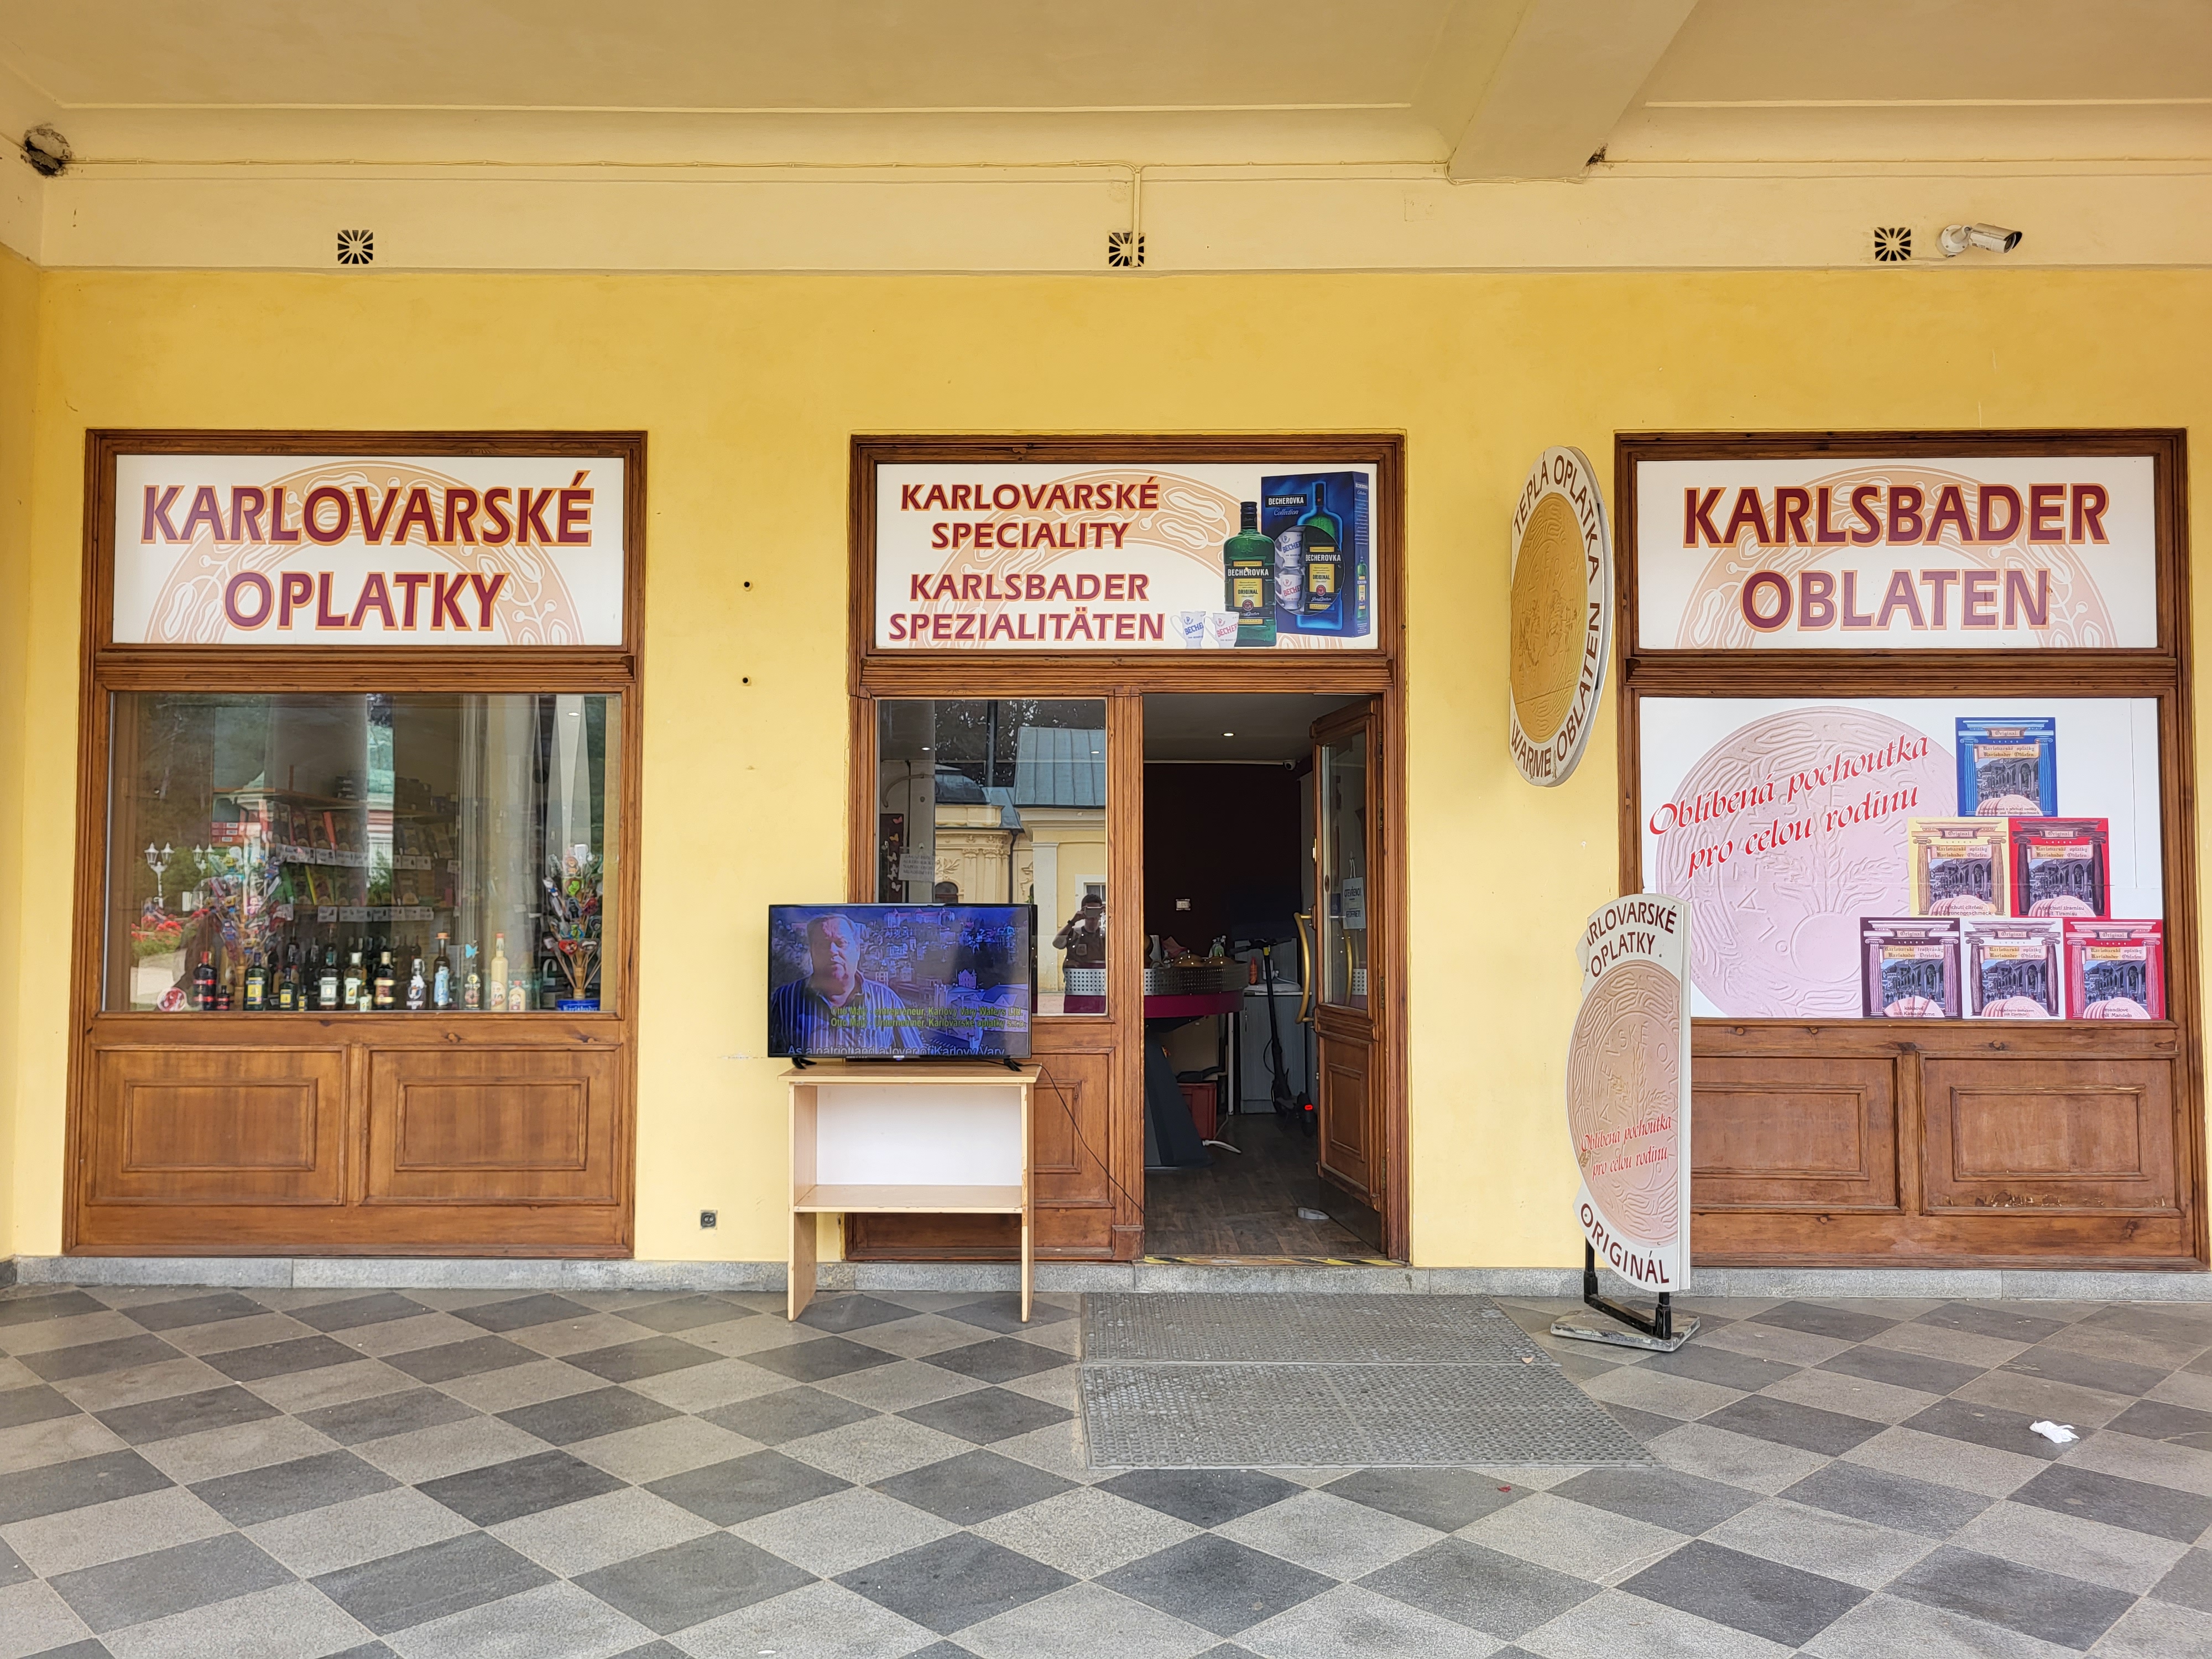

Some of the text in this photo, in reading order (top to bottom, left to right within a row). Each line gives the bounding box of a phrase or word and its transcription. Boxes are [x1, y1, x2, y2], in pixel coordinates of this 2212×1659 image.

[141, 470, 594, 547] KARLOVARSKÉ
[901, 476, 1160, 512] KARLOVARSKÉ
[1268, 497, 1304, 505] BECHEROVKA
[1274, 508, 1299, 516] Collection
[1514, 452, 1599, 585] TEPLÁ OPLATKA
[1683, 483, 2110, 549] KARLSBADER
[931, 522, 1130, 550] SPECIALITY
[909, 573, 1150, 603] KARLSBADER
[1228, 568, 1269, 577] BECHEROVKA
[223, 571, 512, 632] OPLATKY
[1740, 568, 2051, 632] OBLATEN
[888, 606, 1165, 642] SPEZIALITÄTEN
[1511, 718, 1552, 778] WARME
[1557, 603, 1600, 762] OBLATEN
[1649, 732, 1929, 836] Oblíbená pochoutka
[1687, 785, 1920, 881] pro celou rodinu
[1590, 931, 1656, 977] OPLATKY
[831, 1006, 848, 1016] Otto
[875, 1007, 926, 1016] entrepreneur,
[928, 1006, 957, 1018] Karlovy
[959, 1006, 977, 1018] Vary
[979, 1006, 1006, 1016] Wafers
[1008, 1007, 1023, 1016] Ltd.
[831, 1018, 848, 1027] Otto
[875, 1018, 926, 1027] Unternehmer,
[977, 1018, 1005, 1029] oplatky
[788, 1045, 803, 1055] As
[855, 1045, 875, 1055] and
[891, 1045, 917, 1055] lover
[920, 1045, 932, 1055] of
[933, 1045, 978, 1055] Karlovy
[979, 1045, 1005, 1055] Vary
[1580, 1113, 1672, 1152] Oblíbená pochoutka
[1592, 1145, 1668, 1181] pro celou rodinu
[1580, 1203, 1670, 1284] ORIGINÁL
